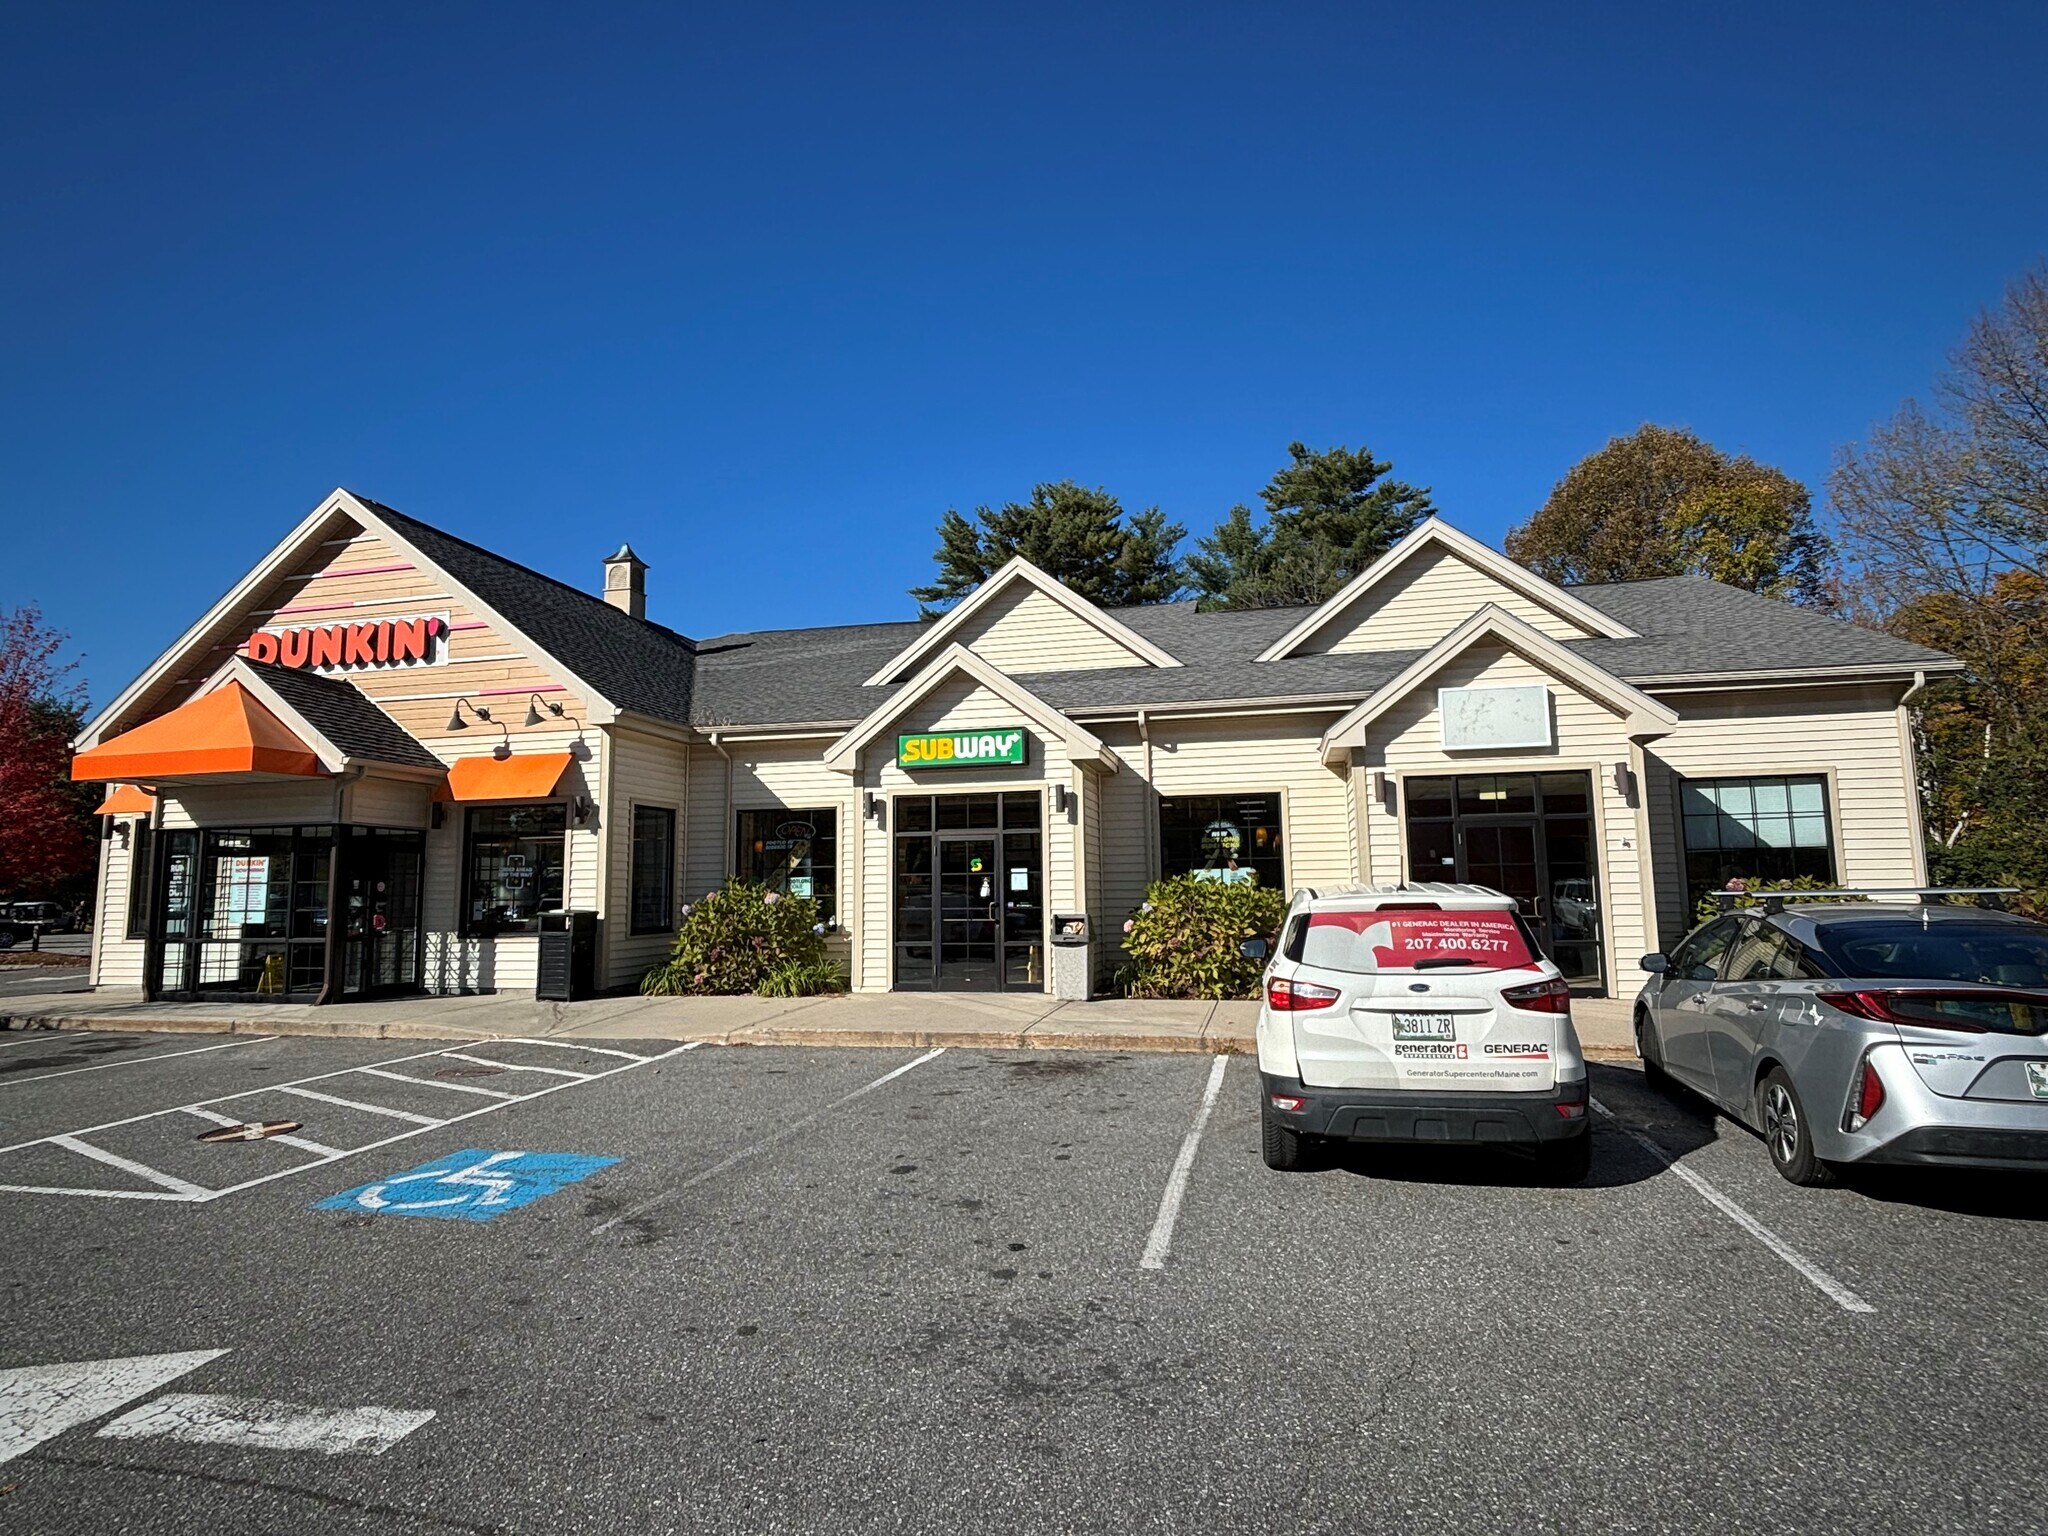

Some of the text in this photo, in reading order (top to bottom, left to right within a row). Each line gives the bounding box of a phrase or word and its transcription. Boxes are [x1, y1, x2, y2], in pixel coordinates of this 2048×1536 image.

[248, 617, 440, 668] DUNKIN'
[901, 732, 1020, 763] SUBWAY
[1481, 922, 1515, 931] AMERICA
[1405, 938, 1509, 952] 207.400.6277
[1403, 1018, 1451, 1033] 3811 ZR
[1395, 1043, 1455, 1055] generator
[1484, 1043, 1548, 1053] GENERAC
